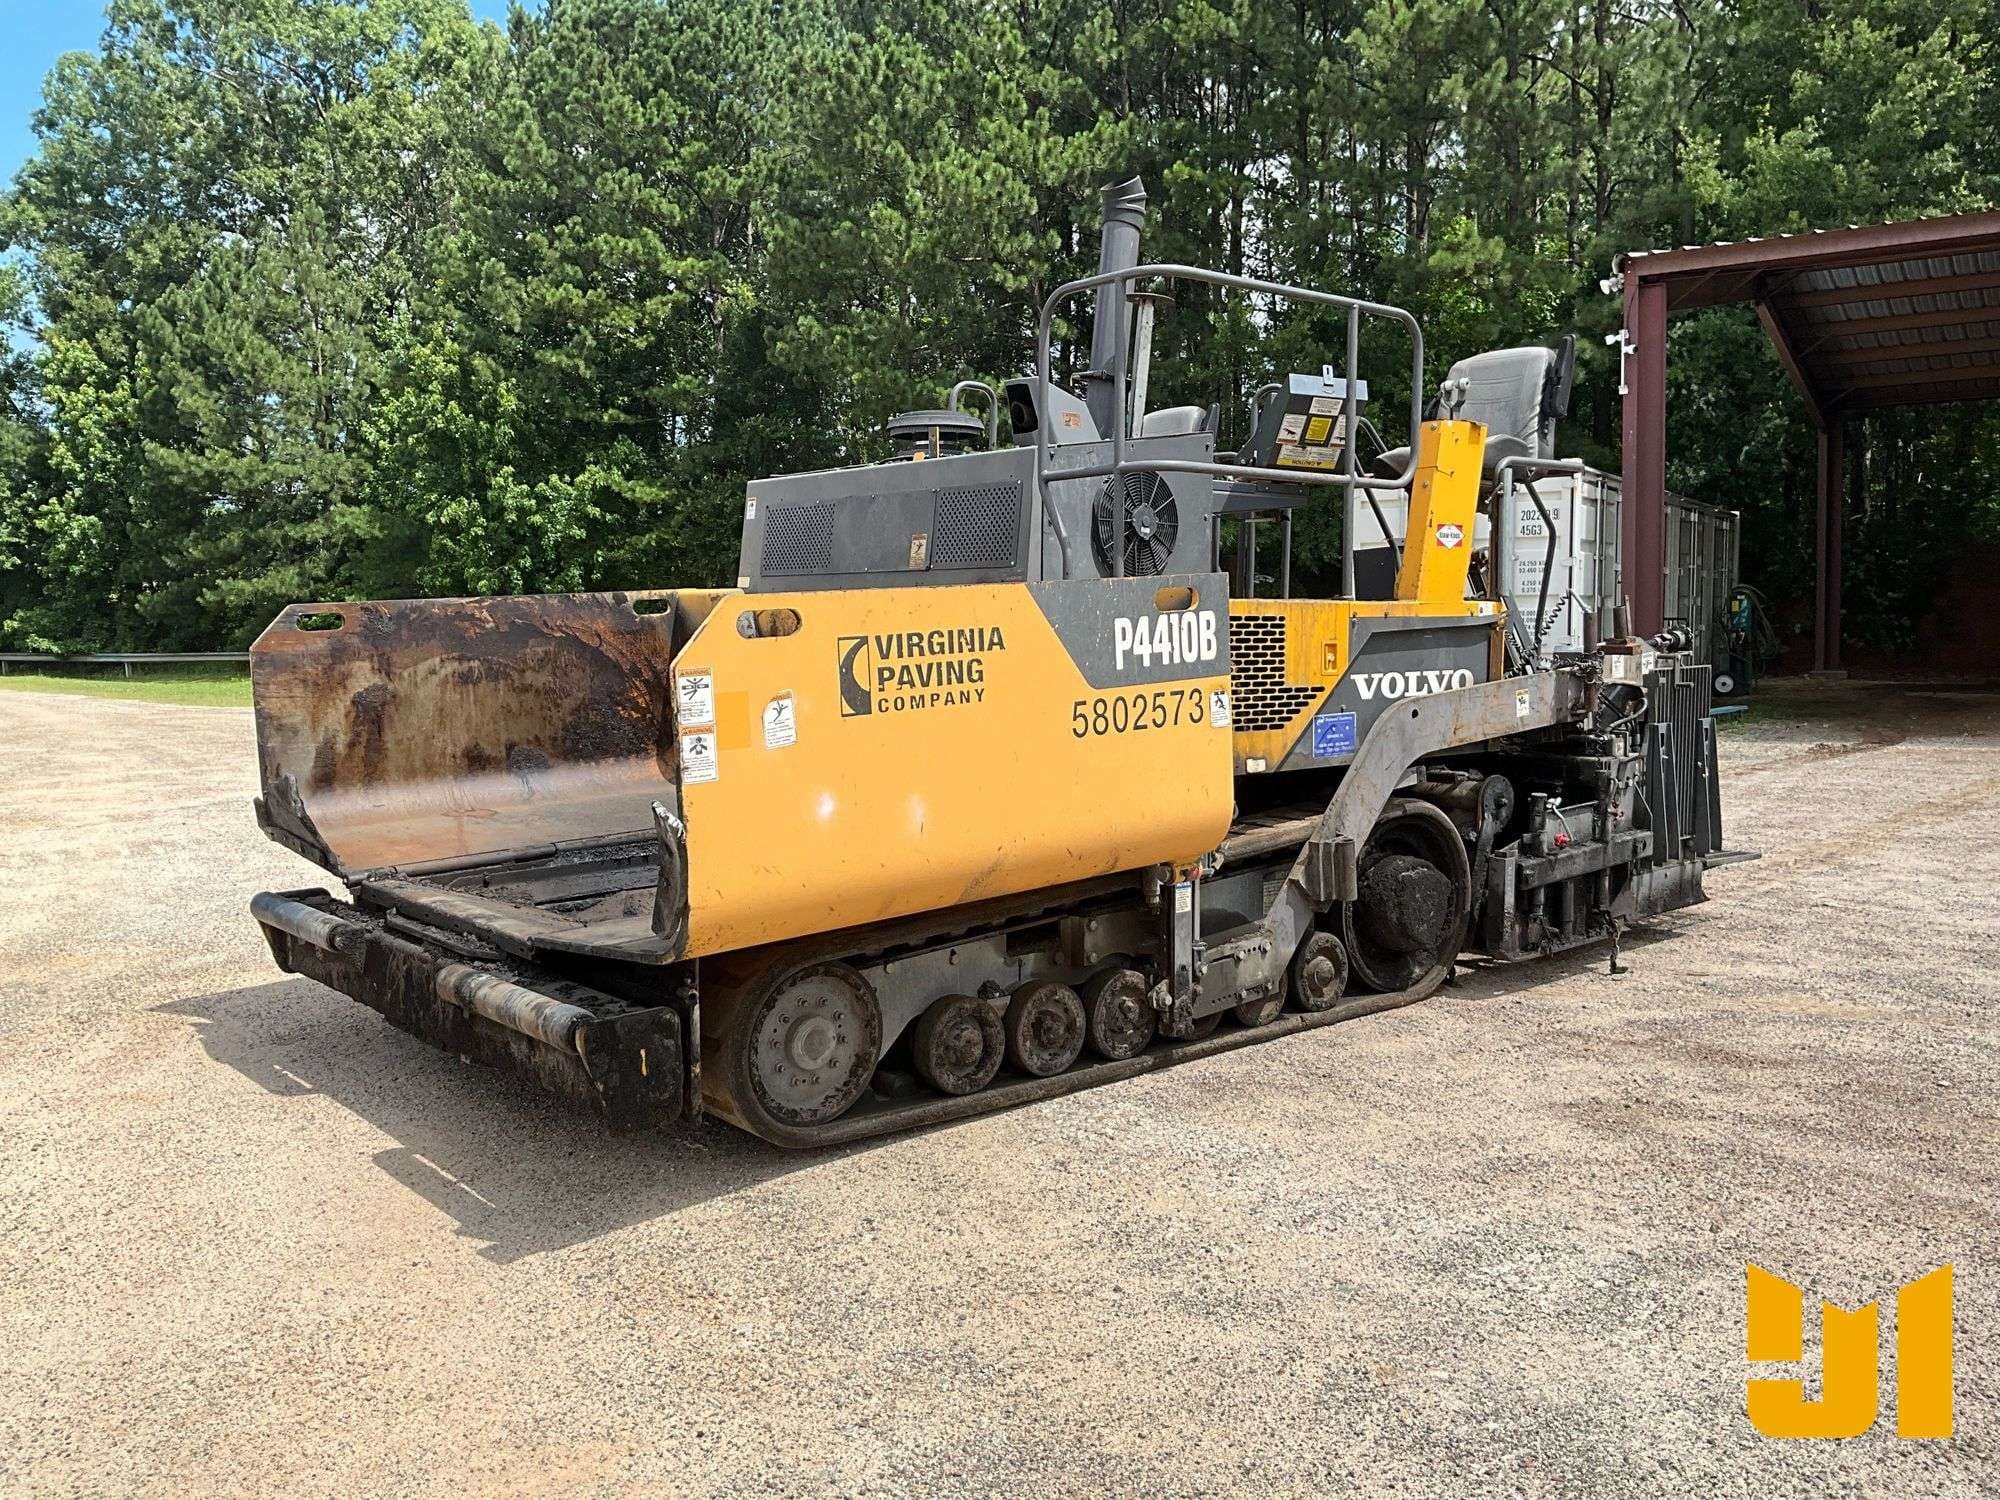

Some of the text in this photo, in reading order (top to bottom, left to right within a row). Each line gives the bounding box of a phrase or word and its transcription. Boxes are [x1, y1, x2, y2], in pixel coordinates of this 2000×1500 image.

[875, 626, 1006, 660] VIRGINIA
[1114, 610, 1217, 670] P4410B
[877, 658, 984, 692] PAVING
[1350, 668, 1475, 700] VOLVO
[878, 688, 985, 713] COMPANY
[1072, 687, 1204, 738] 5802573
